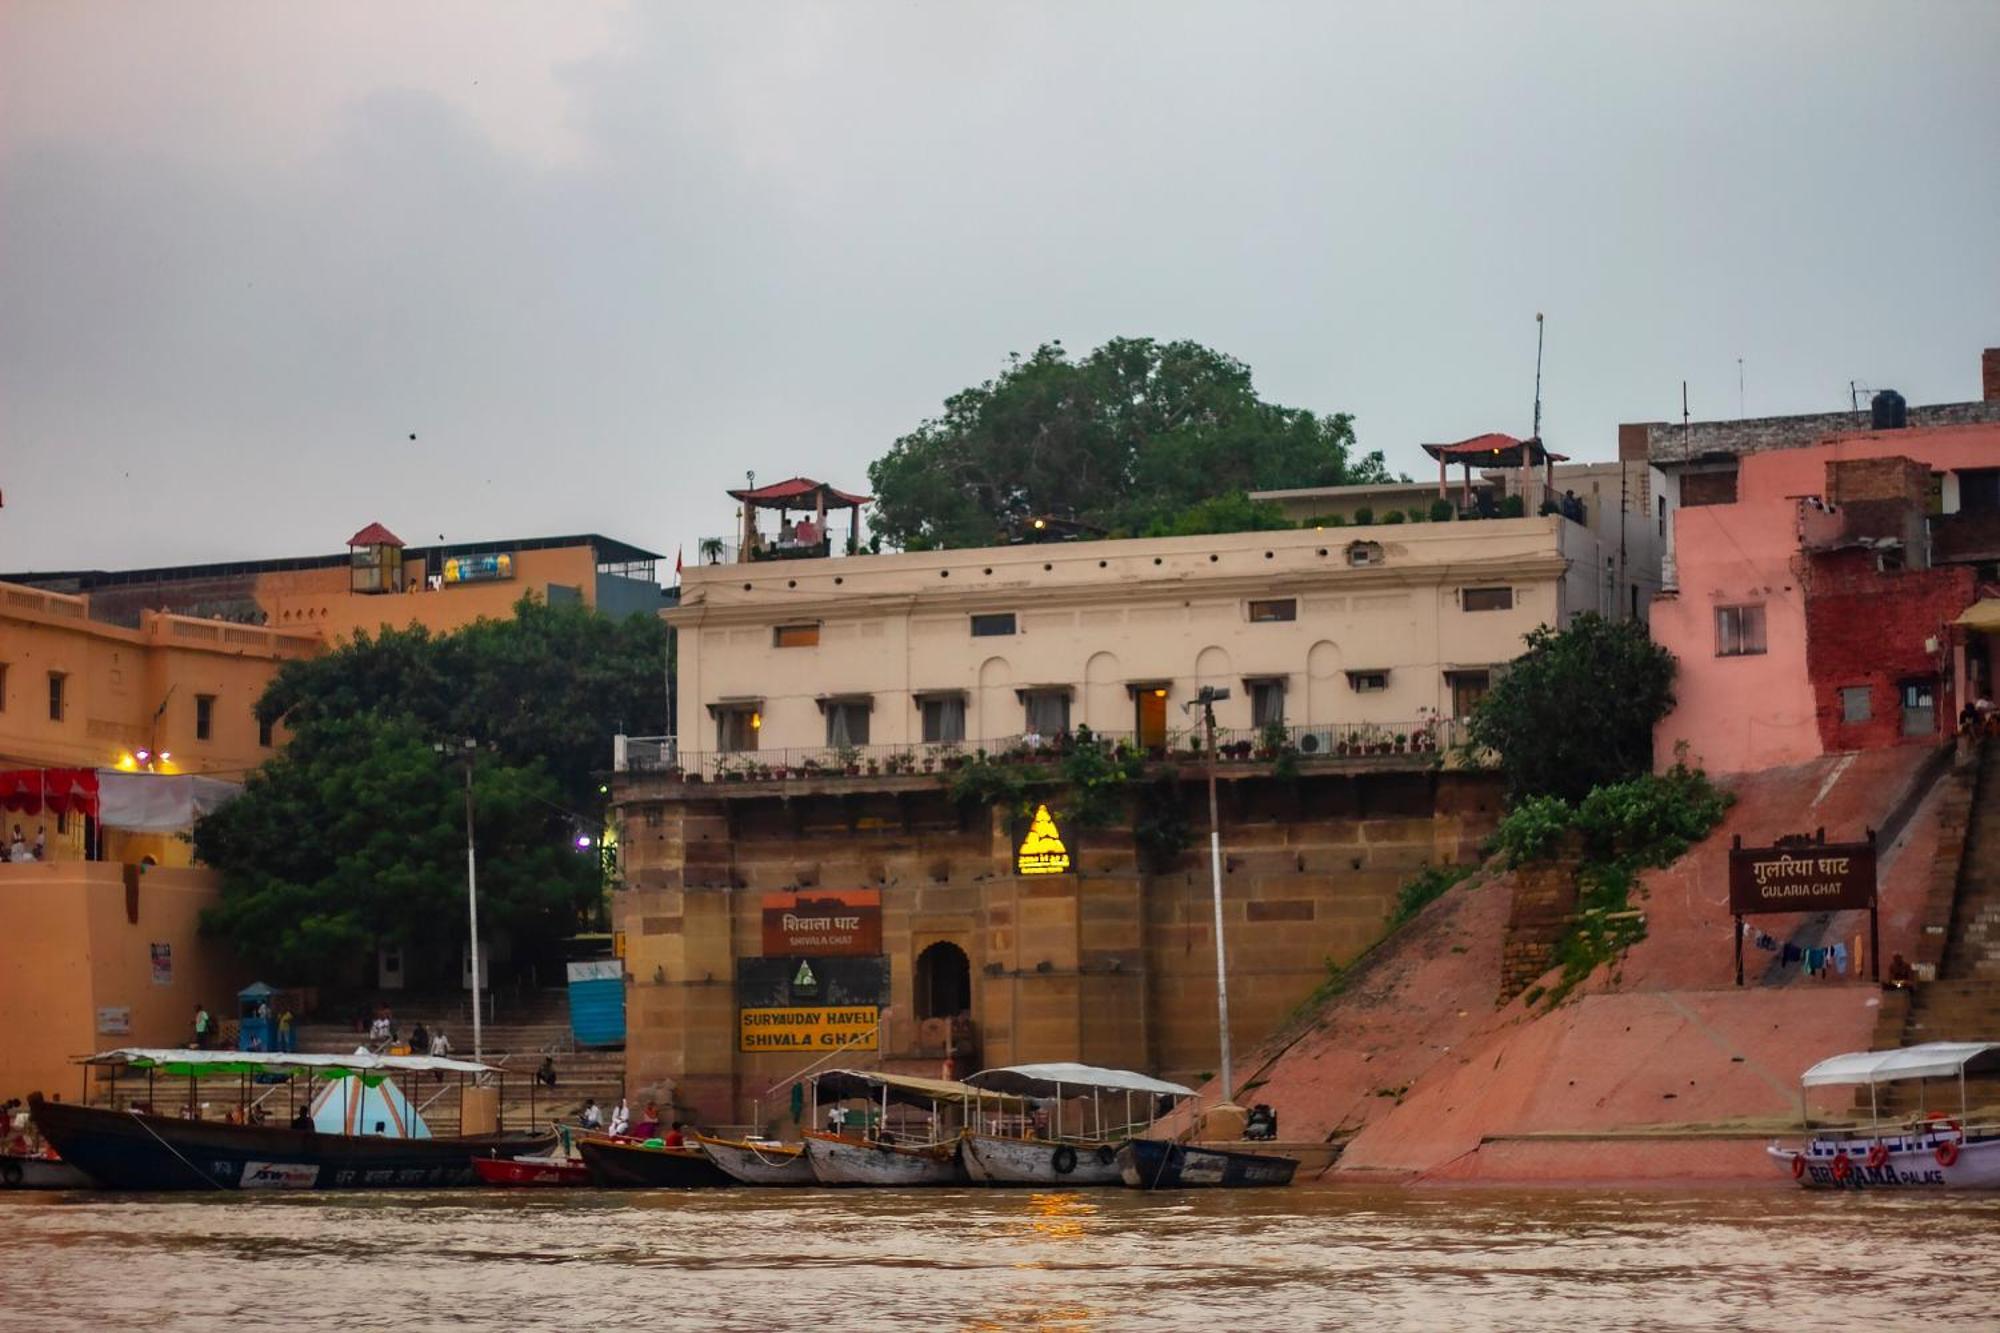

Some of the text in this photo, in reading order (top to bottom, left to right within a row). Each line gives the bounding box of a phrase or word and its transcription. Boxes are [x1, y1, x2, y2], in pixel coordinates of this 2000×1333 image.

[1753, 854, 1849, 884] गुलरिया घाट
[1761, 882, 1842, 898] GULARIA GHAT
[782, 913, 860, 932] शिवाला घाट
[789, 935, 852, 946] SHIVALA GHAT
[743, 1011, 875, 1026] SURYAUDAY HAVELI
[745, 1032, 874, 1046] SHIVALA GHAT
[1901, 1170, 1946, 1186] PALACE
